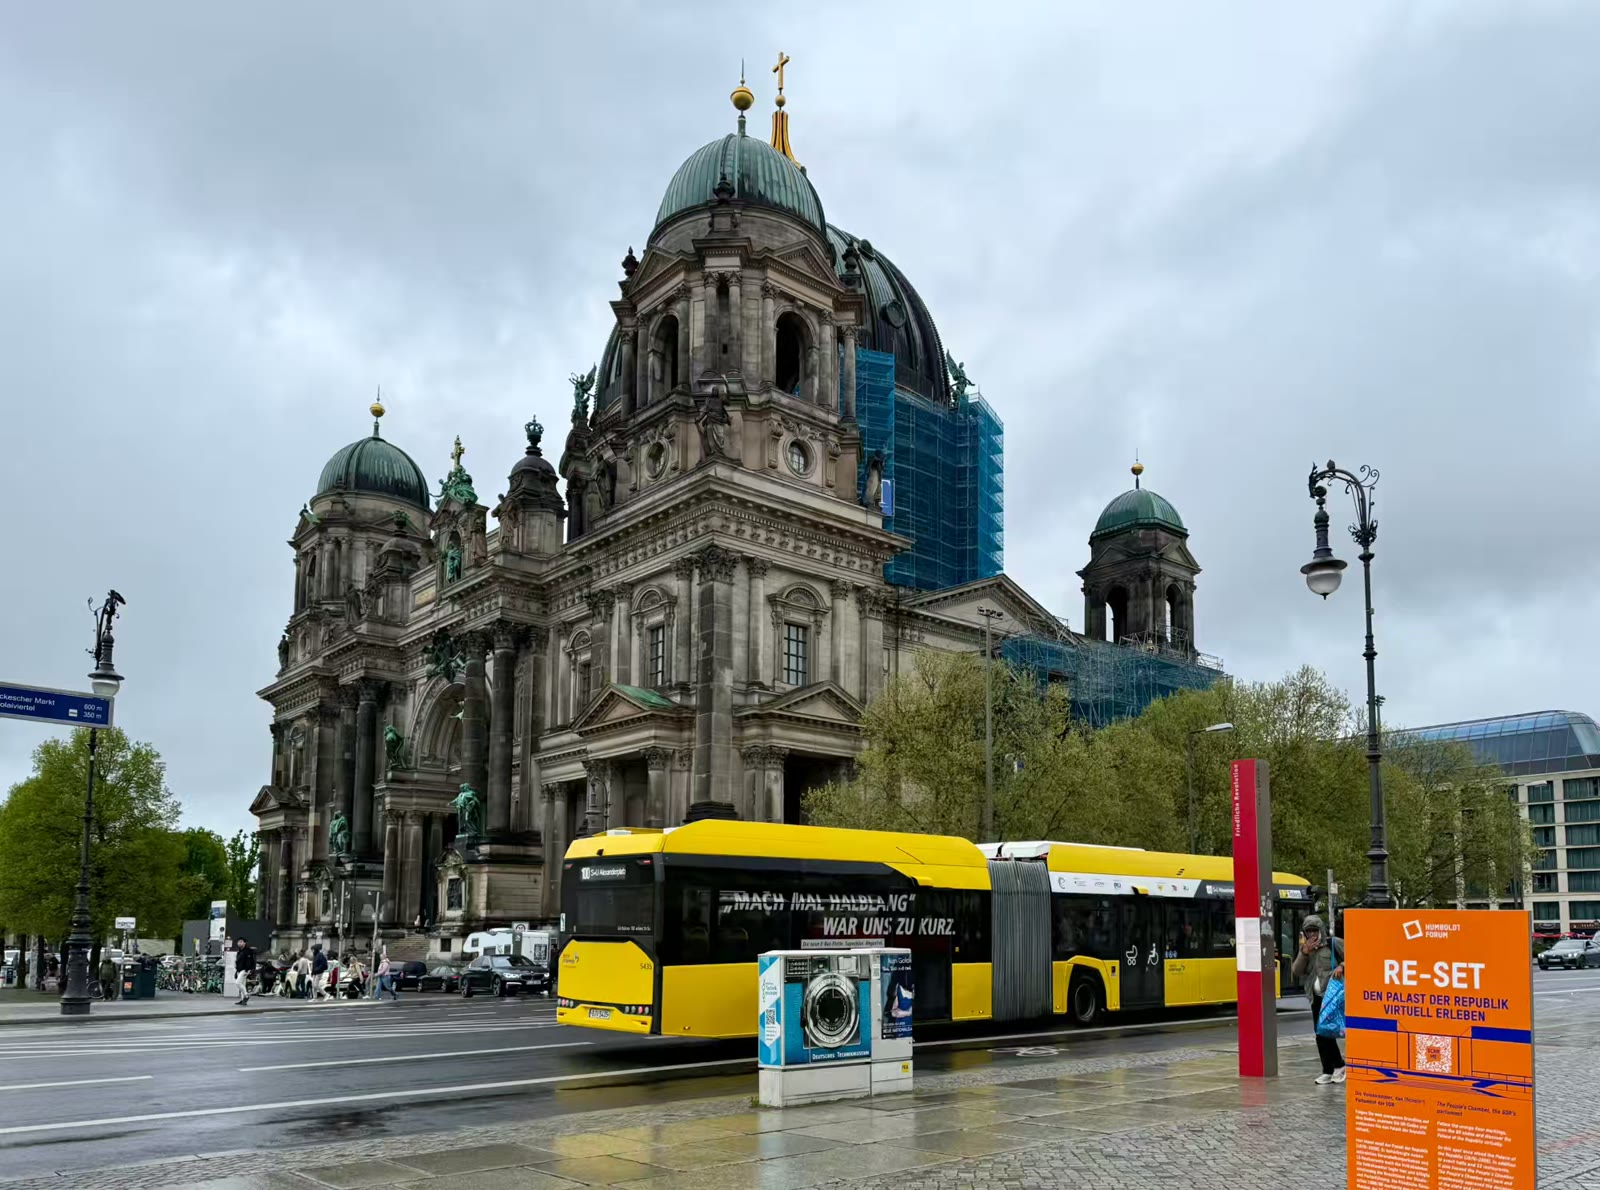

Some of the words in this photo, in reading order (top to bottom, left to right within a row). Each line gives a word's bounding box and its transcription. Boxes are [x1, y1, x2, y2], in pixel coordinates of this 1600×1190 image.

[0, 702, 35, 711] olaiviertel
[35, 697, 55, 705] Markt
[790, 892, 825, 911] MAL
[823, 917, 857, 936] WAR
[862, 917, 892, 934] UNS
[896, 917, 915, 935] ZU
[918, 918, 956, 935] KURZ.
[1384, 959, 1485, 989] RE-SET
[1363, 990, 1383, 1001] DEN
[1386, 992, 1426, 1004] PALAST
[1430, 995, 1450, 1006] DER
[1454, 996, 1509, 1009] REPUBLIK
[1384, 1004, 1432, 1017] VIRTUELL
[1436, 1008, 1485, 1021] ERLEBEN
